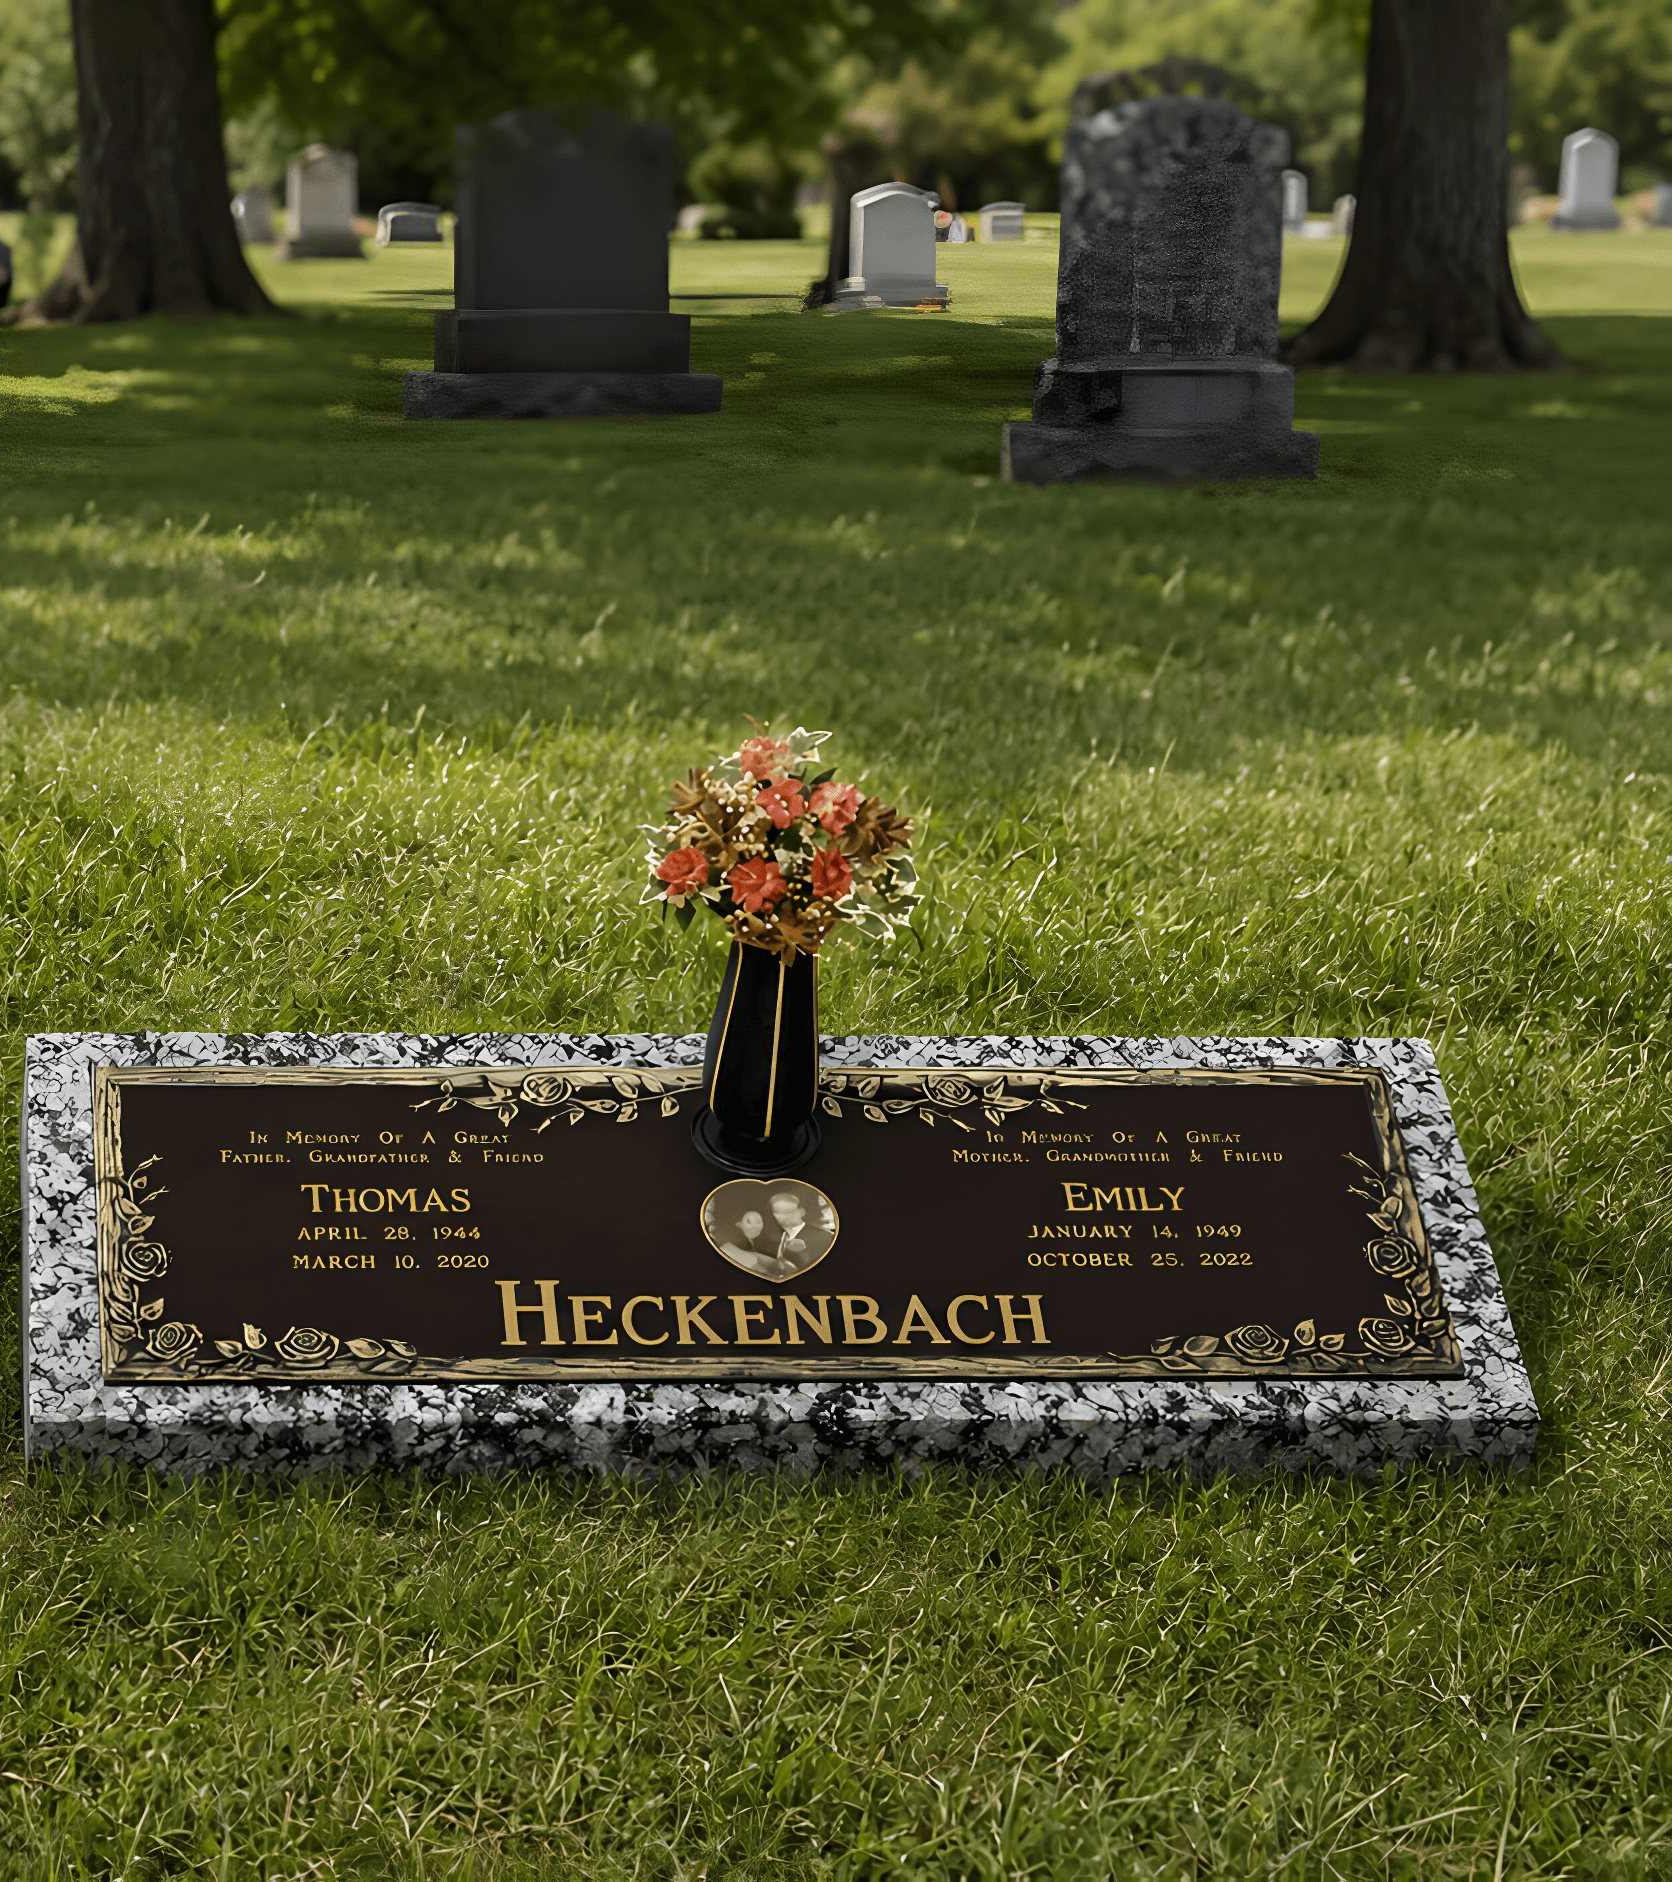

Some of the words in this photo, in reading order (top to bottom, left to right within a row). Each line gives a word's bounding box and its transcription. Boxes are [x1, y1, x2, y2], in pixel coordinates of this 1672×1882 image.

[421, 1130, 436, 1146] A
[1156, 1130, 1169, 1145] A
[448, 1149, 463, 1164] &
[1189, 1148, 1205, 1164] &
[300, 1184, 472, 1213] THOMAS
[1060, 1182, 1186, 1212] EMILY
[297, 1226, 368, 1241] APRIL
[1027, 1224, 1133, 1239] JANUARY
[292, 1254, 376, 1270] MARCH
[437, 1254, 490, 1269] 2020
[1027, 1252, 1134, 1267] OCTOBER
[1199, 1252, 1254, 1266] 2022
[494, 1278, 1053, 1347] HECKENBACH
